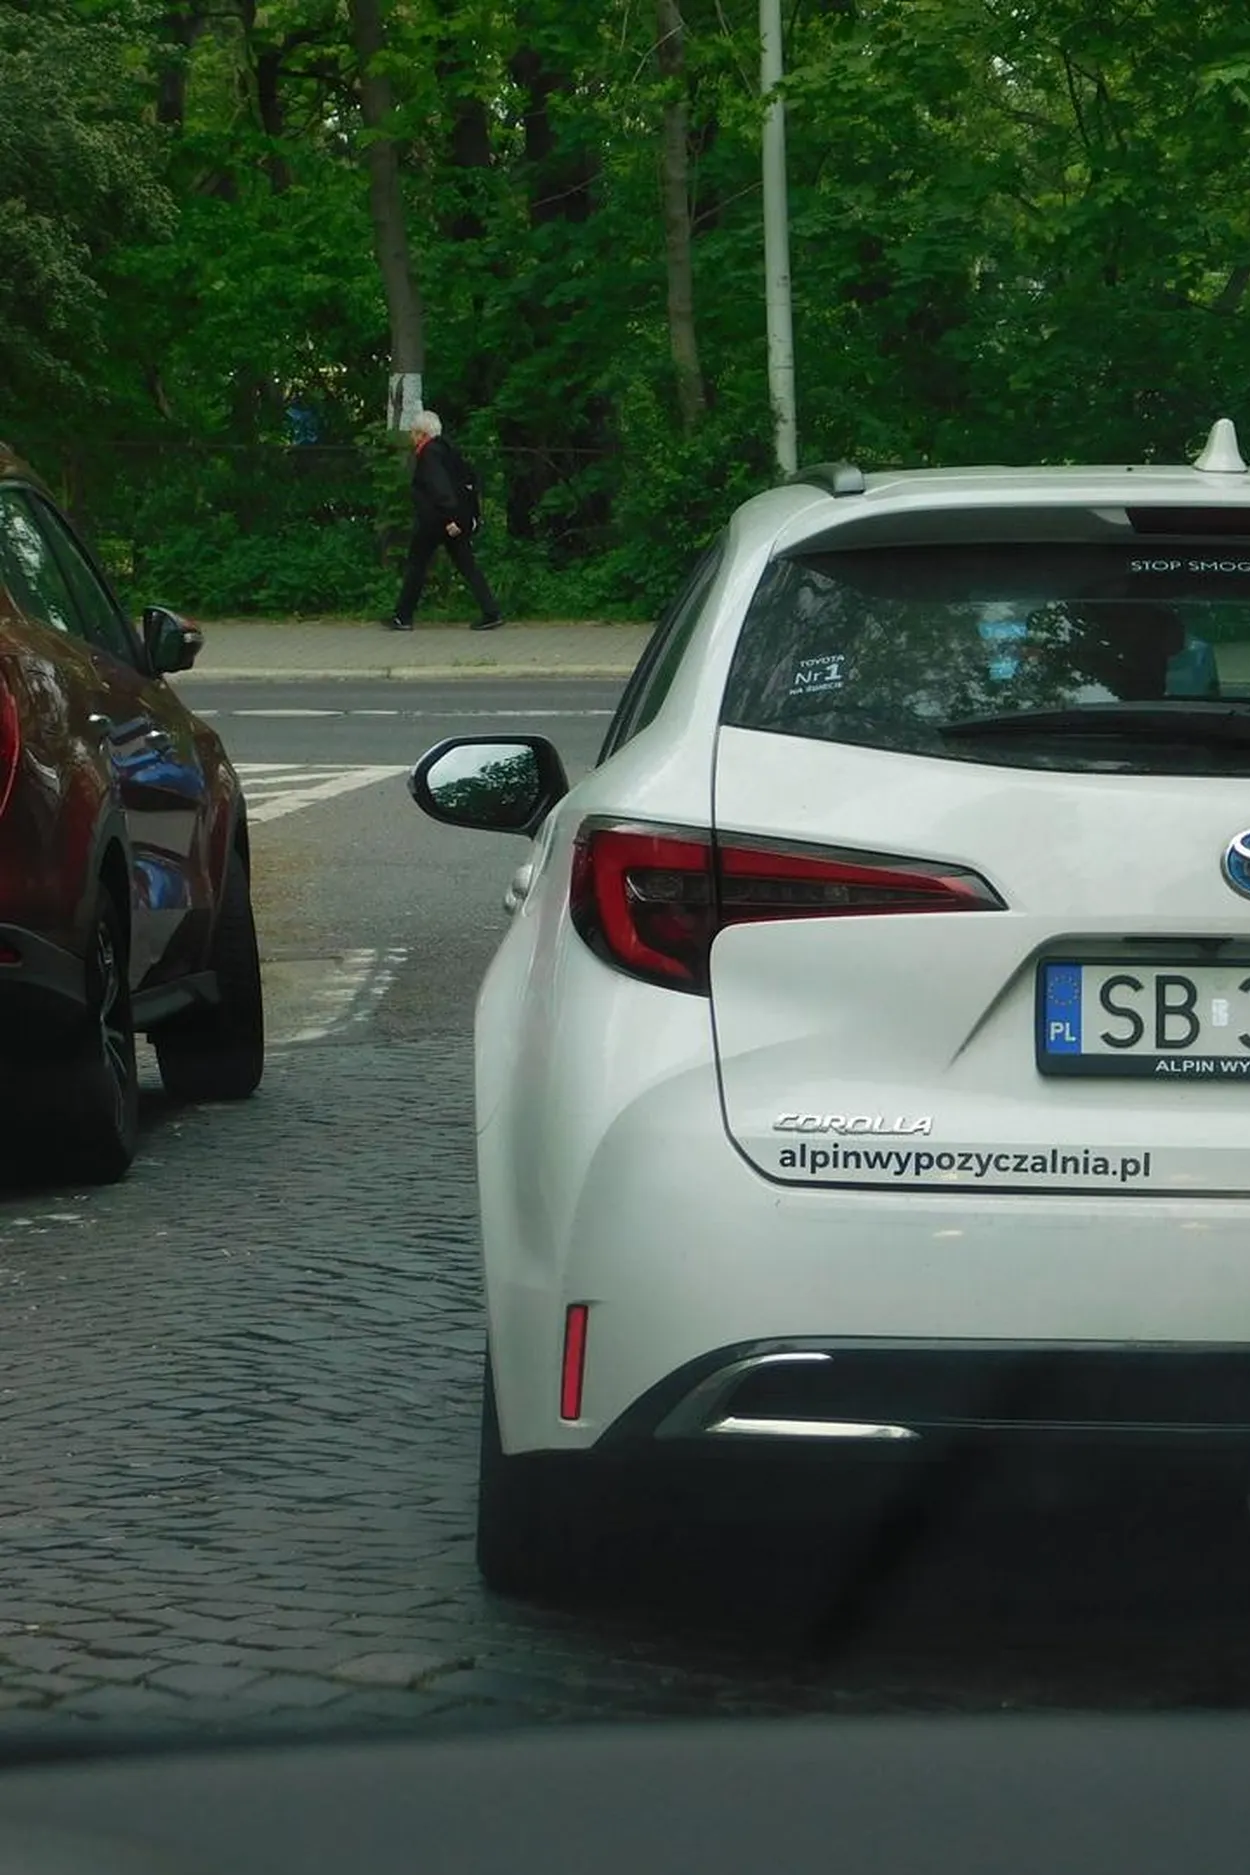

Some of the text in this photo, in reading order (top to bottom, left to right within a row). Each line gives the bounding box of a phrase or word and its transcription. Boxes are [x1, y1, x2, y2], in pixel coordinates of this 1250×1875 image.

[1131, 560, 1181, 572] STOP
[800, 654, 845, 667] TOYOTA
[1099, 974, 1200, 1050] SB
[1050, 1022, 1076, 1042] PL
[1155, 1060, 1214, 1073] ALPIN
[773, 1112, 933, 1136] COROLLA
[779, 1143, 1150, 1181] alpinwypozyczalnia.pl
